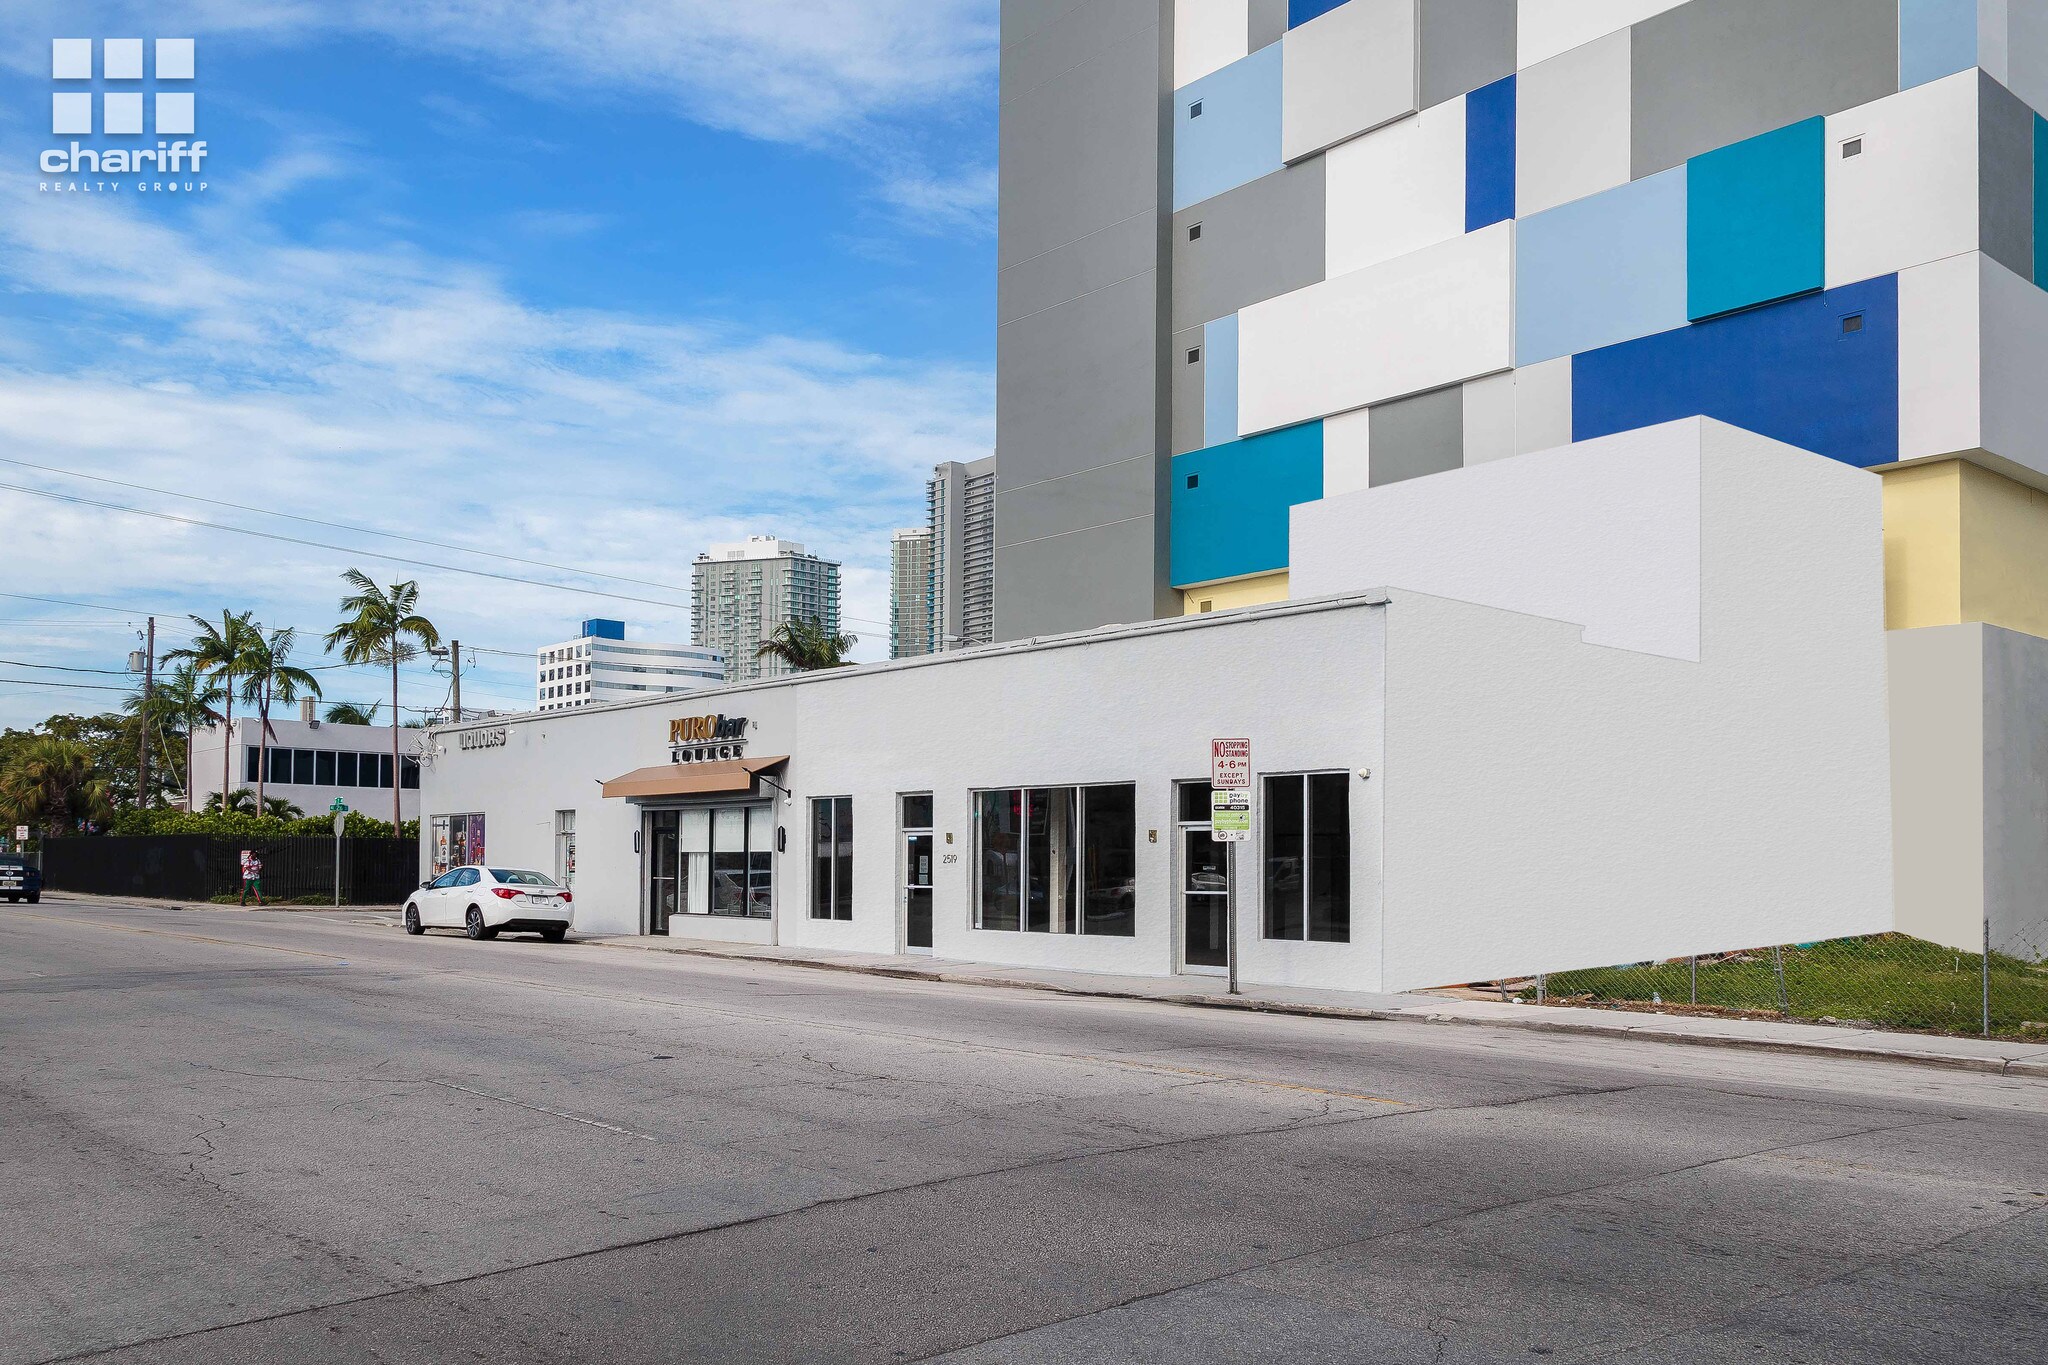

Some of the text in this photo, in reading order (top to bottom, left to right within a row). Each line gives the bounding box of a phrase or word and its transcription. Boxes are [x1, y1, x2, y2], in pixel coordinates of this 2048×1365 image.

[671, 745, 744, 764] LOUNGE
[1214, 742, 1225, 758] NO
[1226, 750, 1249, 758] STANDING
[943, 854, 958, 864] 2519
